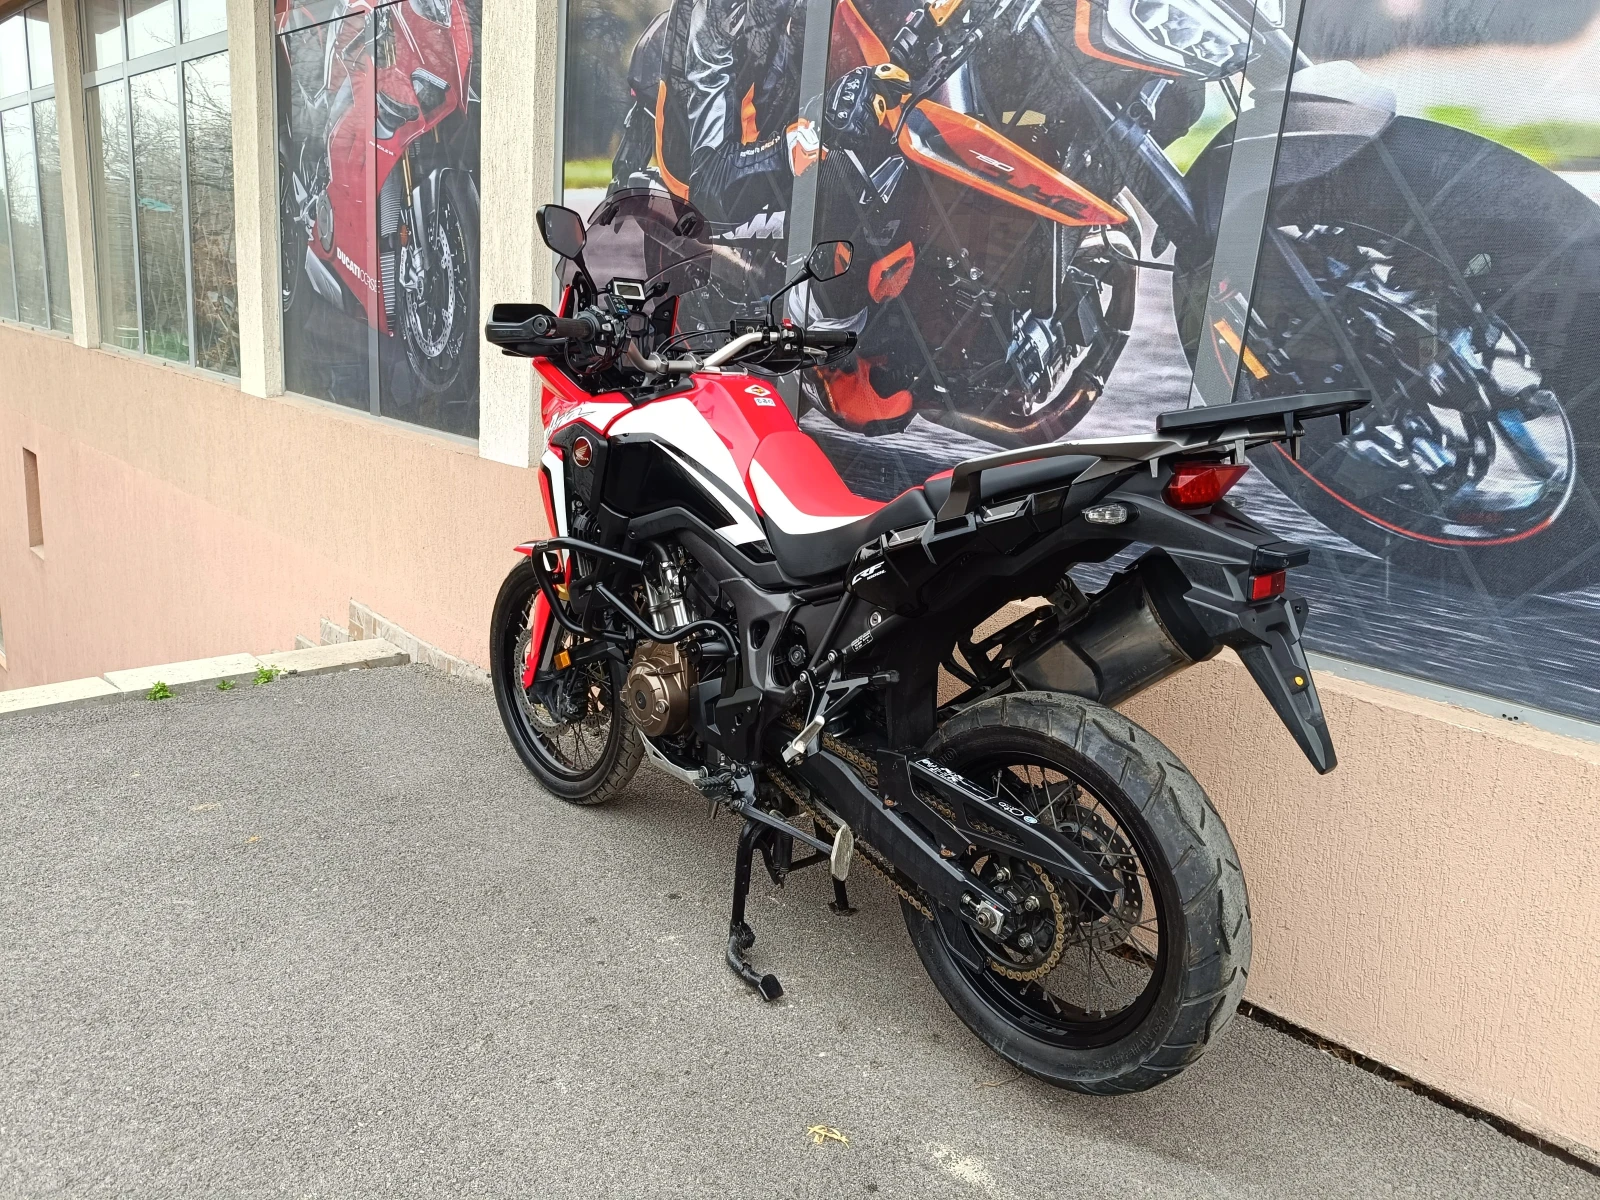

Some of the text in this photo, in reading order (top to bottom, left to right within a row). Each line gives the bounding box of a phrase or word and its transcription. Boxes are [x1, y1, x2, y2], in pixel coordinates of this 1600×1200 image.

[968, 149, 1015, 172] 790
[336, 246, 361, 279] DUCATI
[851, 560, 886, 586] CRF
